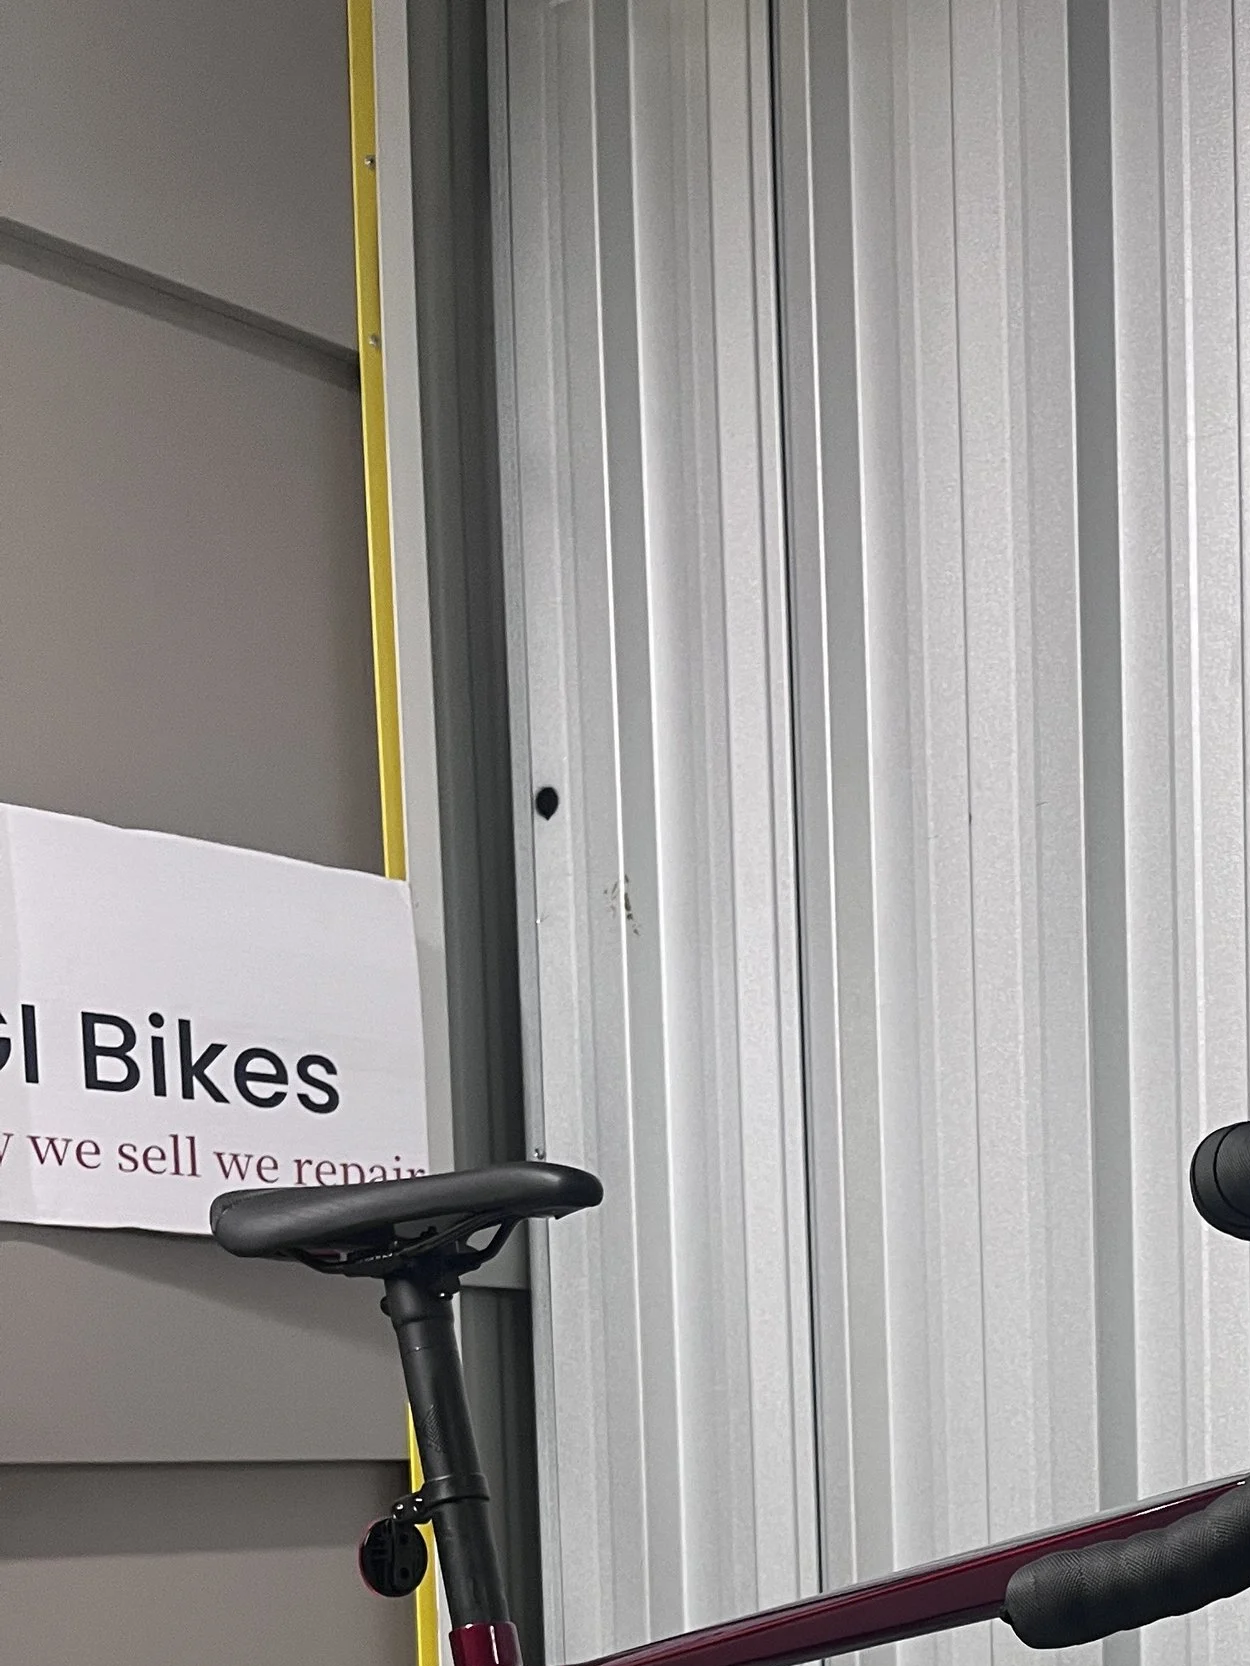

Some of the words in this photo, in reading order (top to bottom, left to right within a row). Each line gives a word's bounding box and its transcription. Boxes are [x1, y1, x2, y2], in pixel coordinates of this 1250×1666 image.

[81, 1011, 340, 1115] Bikes
[26, 1134, 101, 1169] we
[117, 1133, 200, 1178] sell
[213, 1151, 279, 1184] we
